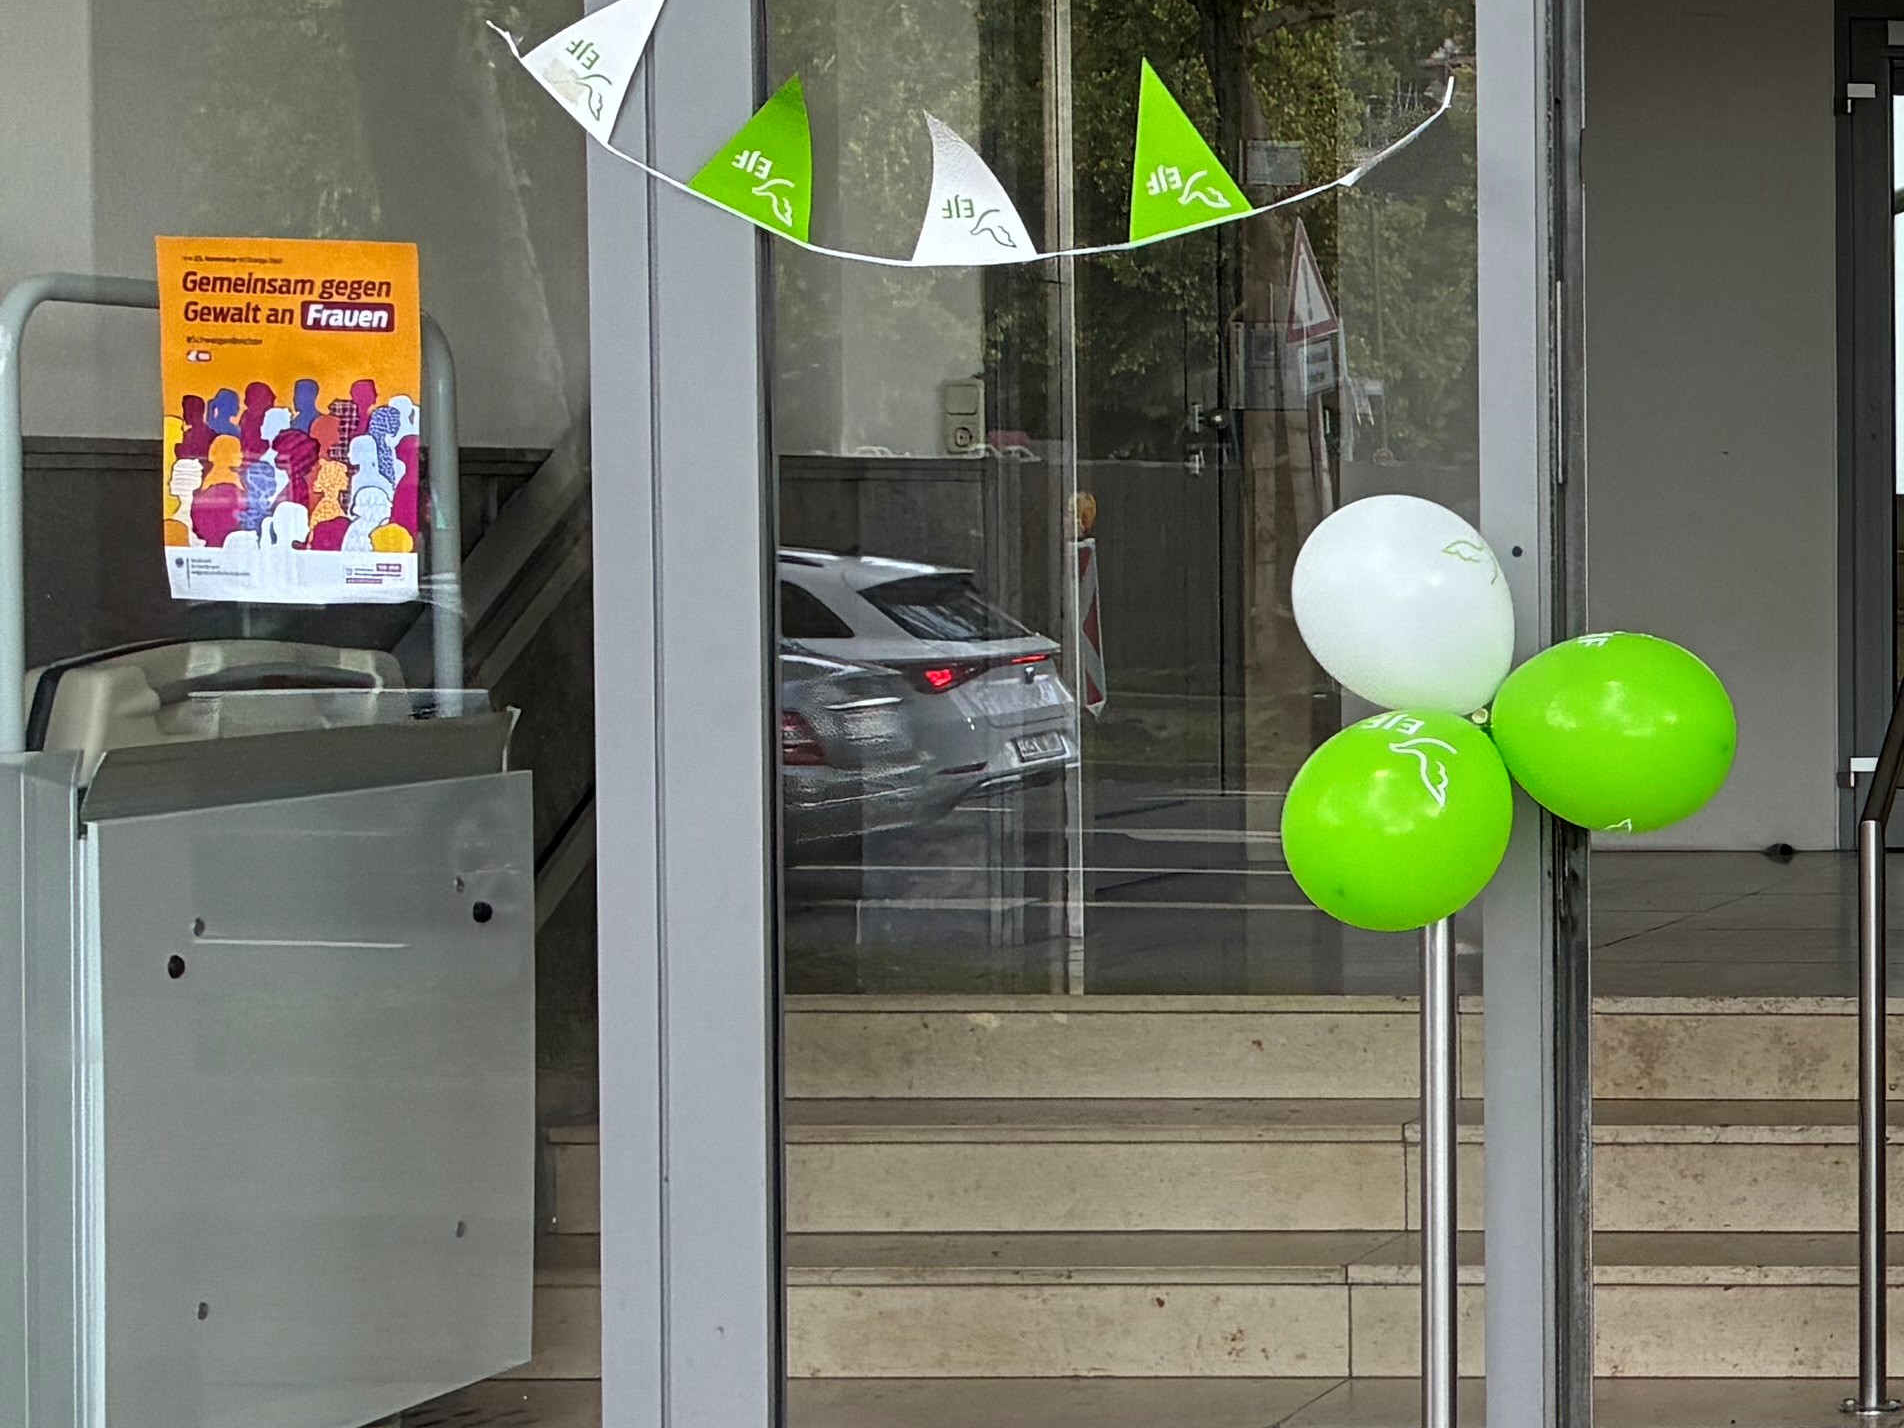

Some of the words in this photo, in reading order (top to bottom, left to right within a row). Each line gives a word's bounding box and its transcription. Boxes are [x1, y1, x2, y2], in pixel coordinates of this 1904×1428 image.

[565, 38, 600, 70] EJF
[731, 149, 774, 180] EJF
[1146, 164, 1183, 196] EJF
[942, 194, 975, 219] EJF
[182, 270, 315, 295] Gemeinsam
[319, 278, 392, 300] gegen
[184, 300, 262, 324] Gewalt
[266, 306, 295, 325] an
[306, 303, 389, 329] Frauen
